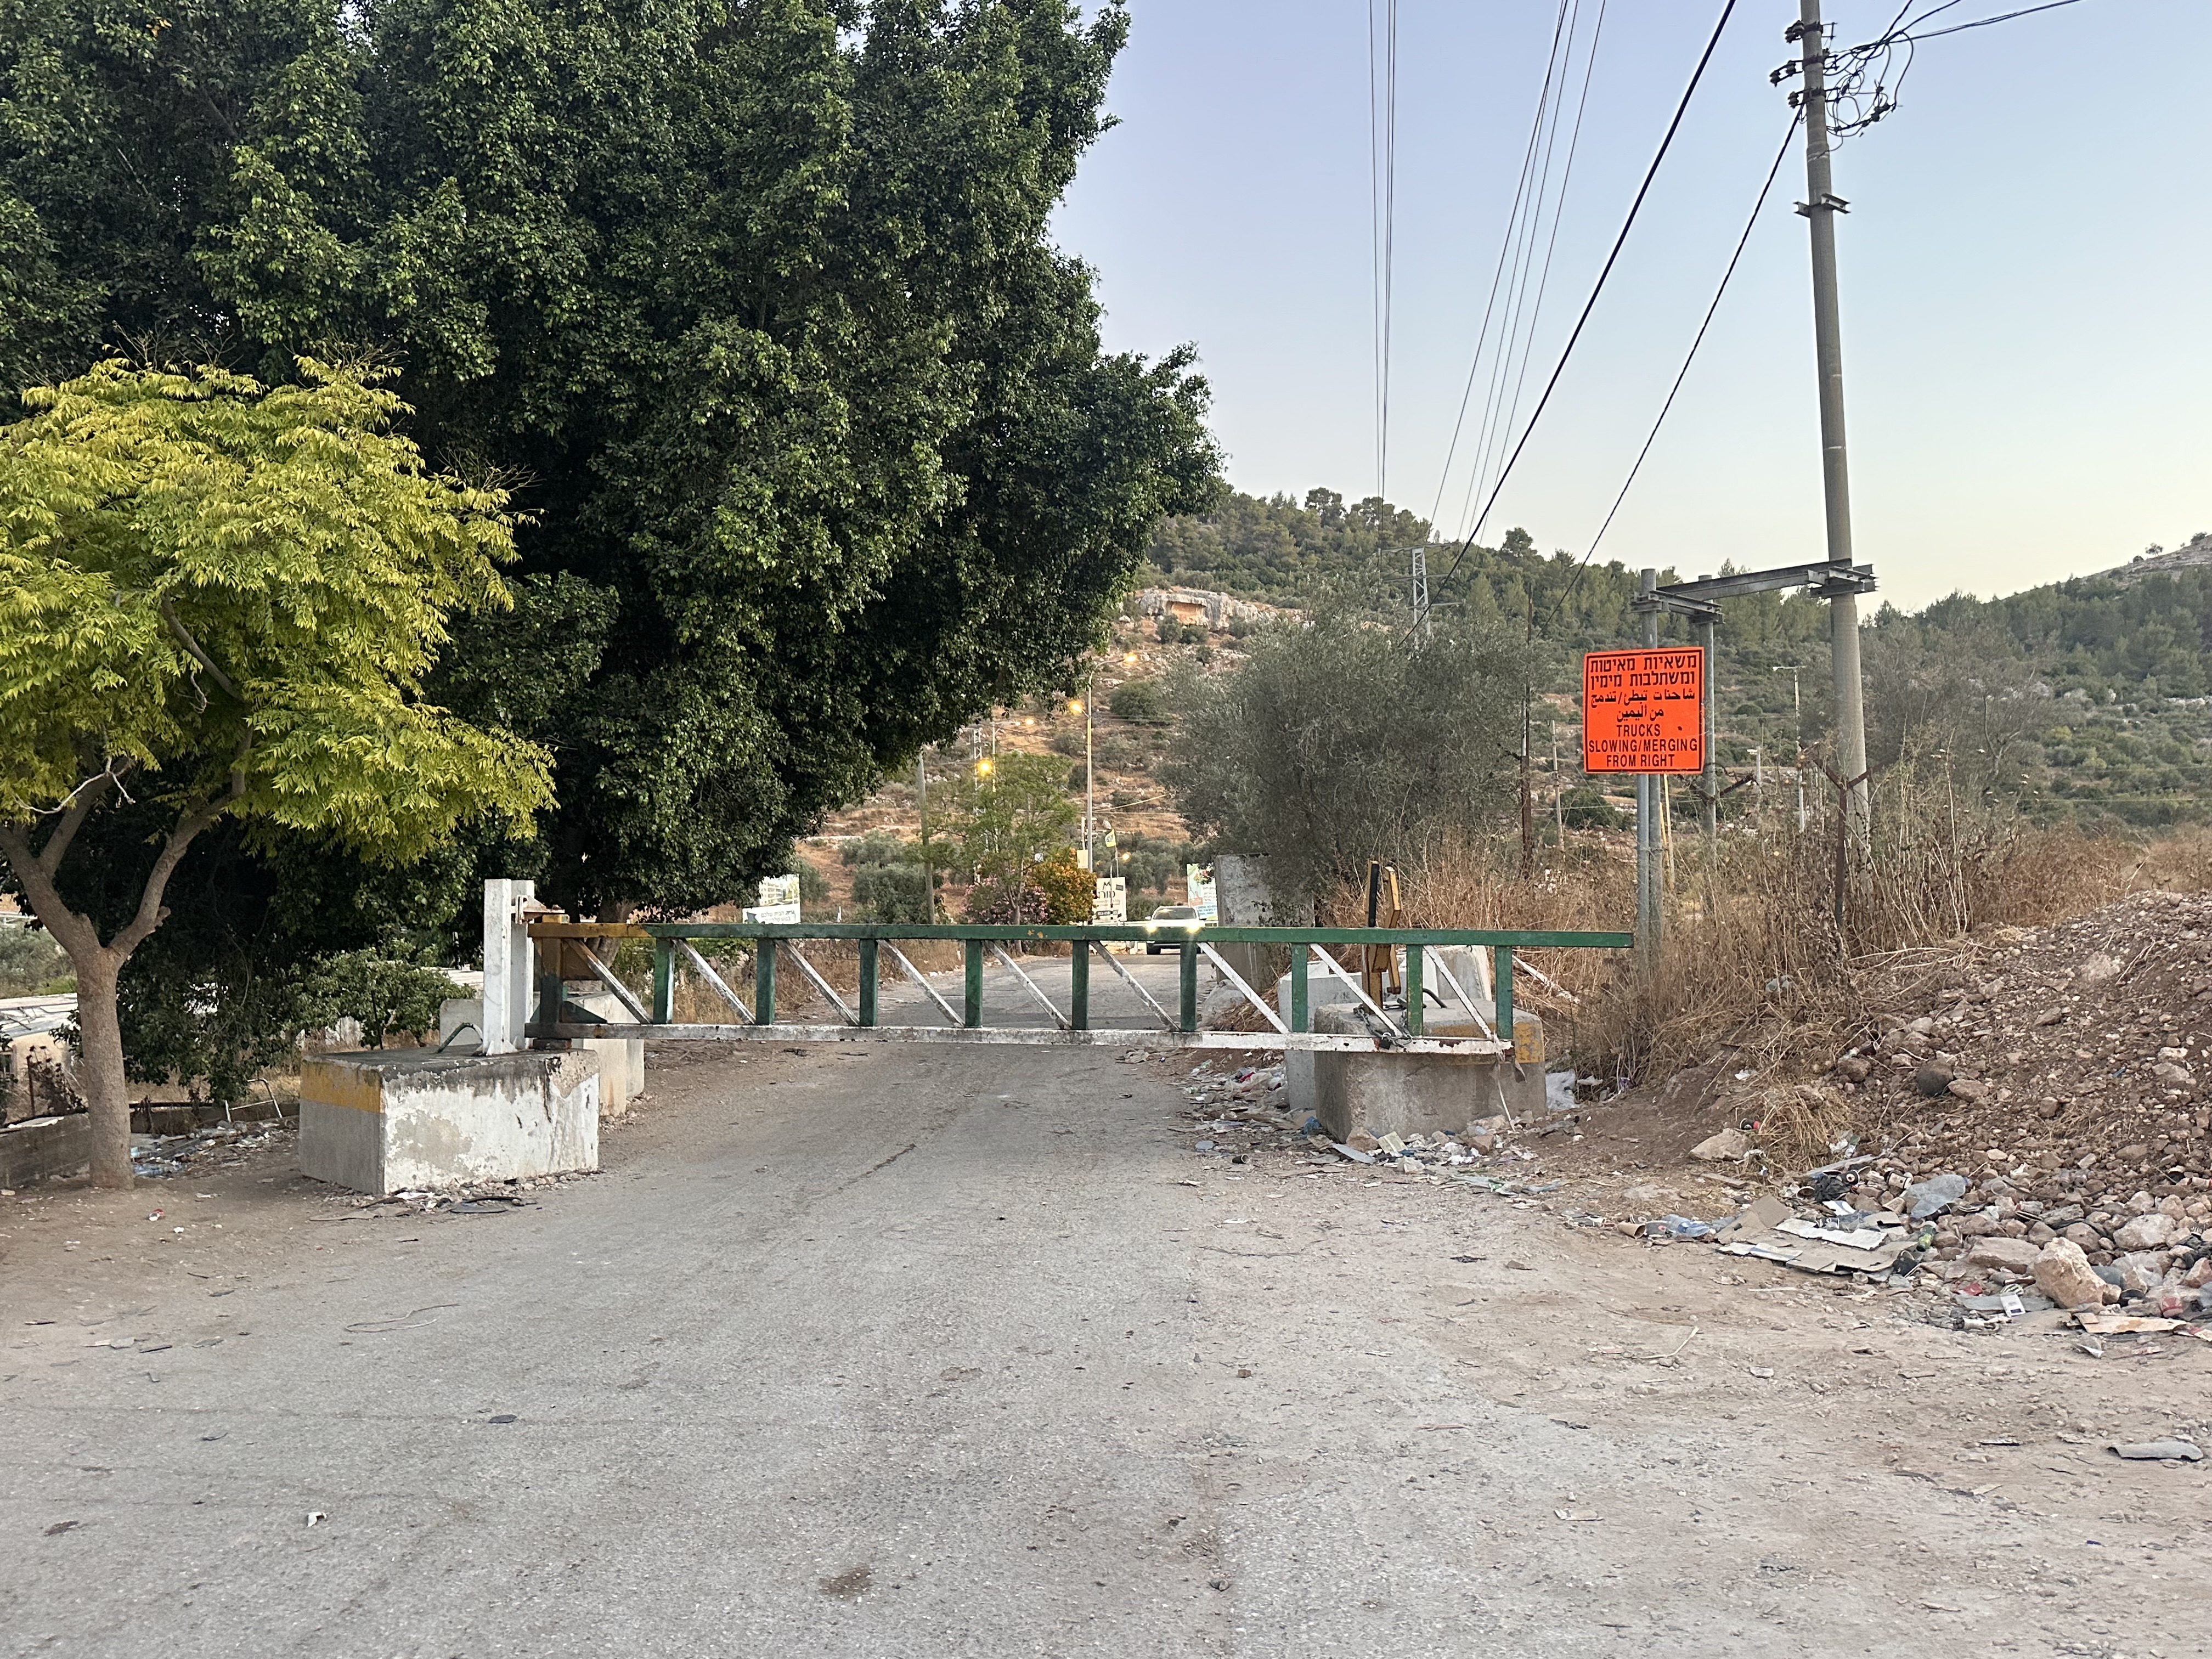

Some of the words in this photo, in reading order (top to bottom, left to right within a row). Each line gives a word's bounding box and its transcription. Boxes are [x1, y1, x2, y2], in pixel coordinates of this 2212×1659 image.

[1590, 658, 1635, 673] מאיטות
[1643, 655, 1697, 670] משאיות
[1590, 674, 1622, 690] מימין
[1629, 670, 1695, 686] ומשתלבות
[1591, 689, 1647, 709] تبطئ/تندمج
[1653, 687, 1695, 701] شاحنات
[1649, 708, 1664, 721] من
[1616, 723, 1661, 737] TRUCKS
[1589, 738, 1697, 753] SLOWING/MERGING
[1606, 754, 1636, 767] FROM
[1640, 754, 1675, 767] RIGHT
